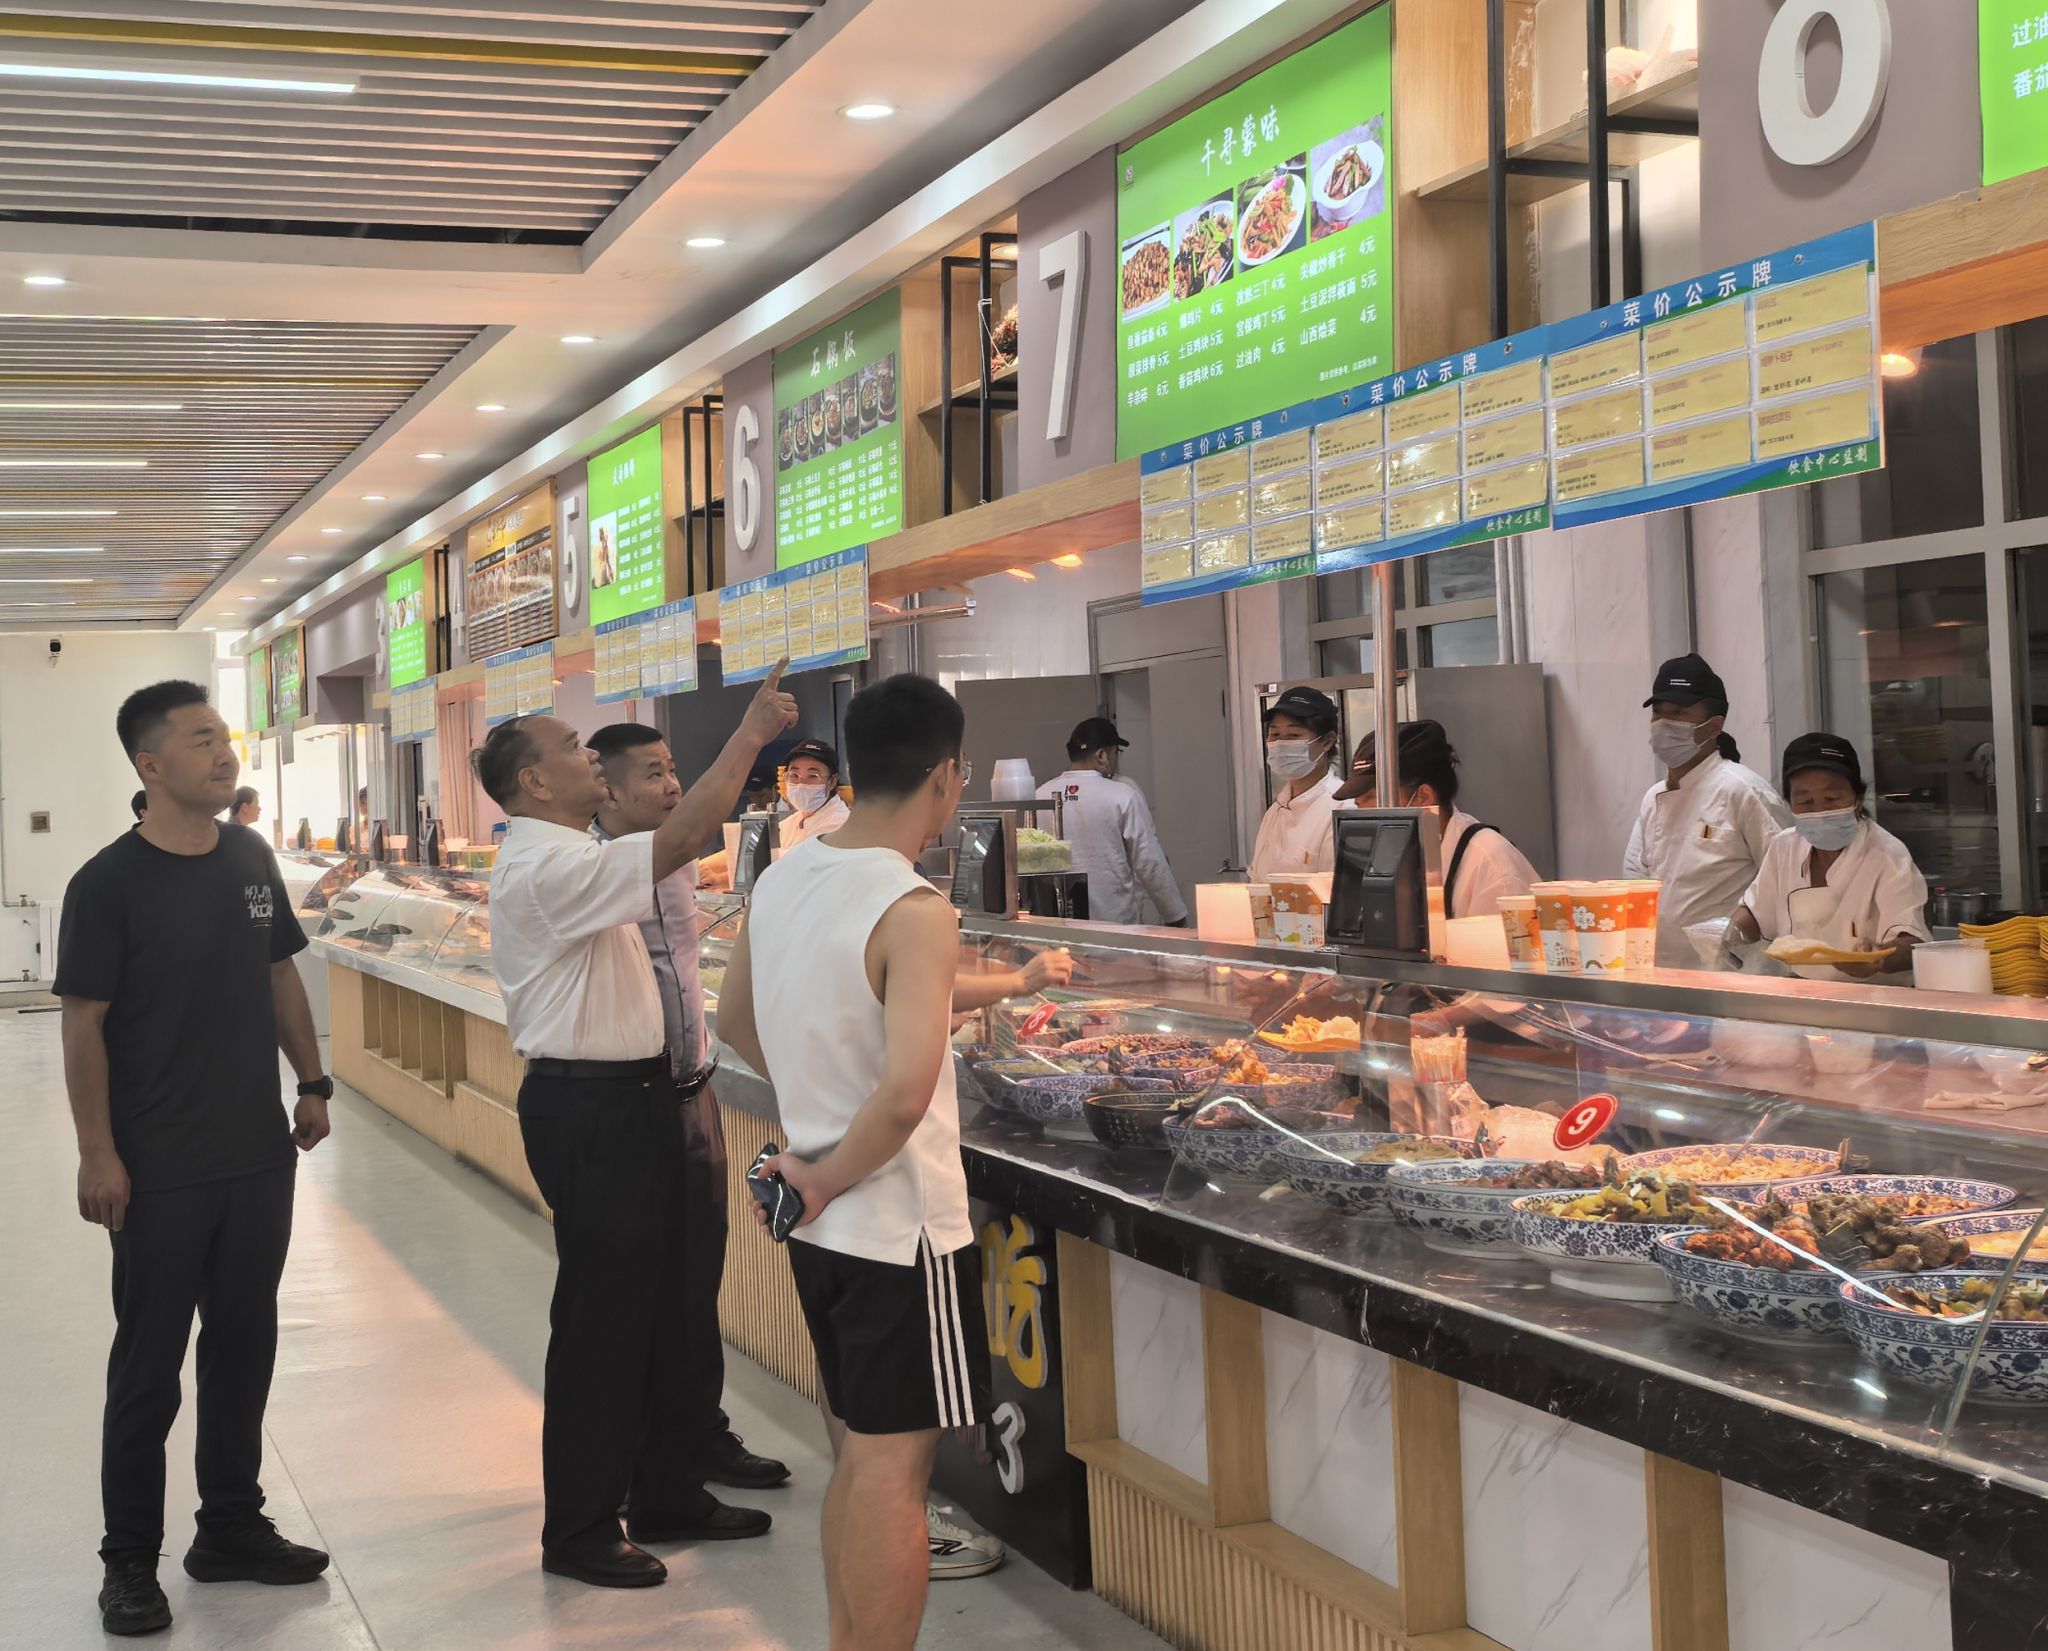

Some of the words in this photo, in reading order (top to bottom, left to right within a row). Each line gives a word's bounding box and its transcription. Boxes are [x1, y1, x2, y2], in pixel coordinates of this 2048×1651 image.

[1361, 269, 1377, 289] 5元
[1623, 260, 1772, 327] 菜价公示牌
[1271, 305, 1286, 323] 5元
[1360, 304, 1376, 324] 4元
[1039, 230, 1087, 440] 7
[1210, 330, 1224, 346] 5元
[1271, 338, 1286, 355] 4元
[1210, 360, 1224, 377] 6元
[1370, 353, 1478, 405] 菜价公示牌
[1183, 420, 1263, 460] 菜价公示牌
[1787, 444, 1868, 476] 饮食中心监制
[733, 404, 761, 551] 6
[562, 496, 580, 609] 5
[450, 557, 467, 647] 4
[1028, 1010, 1047, 1030] 8
[1568, 1106, 1598, 1136] 9
